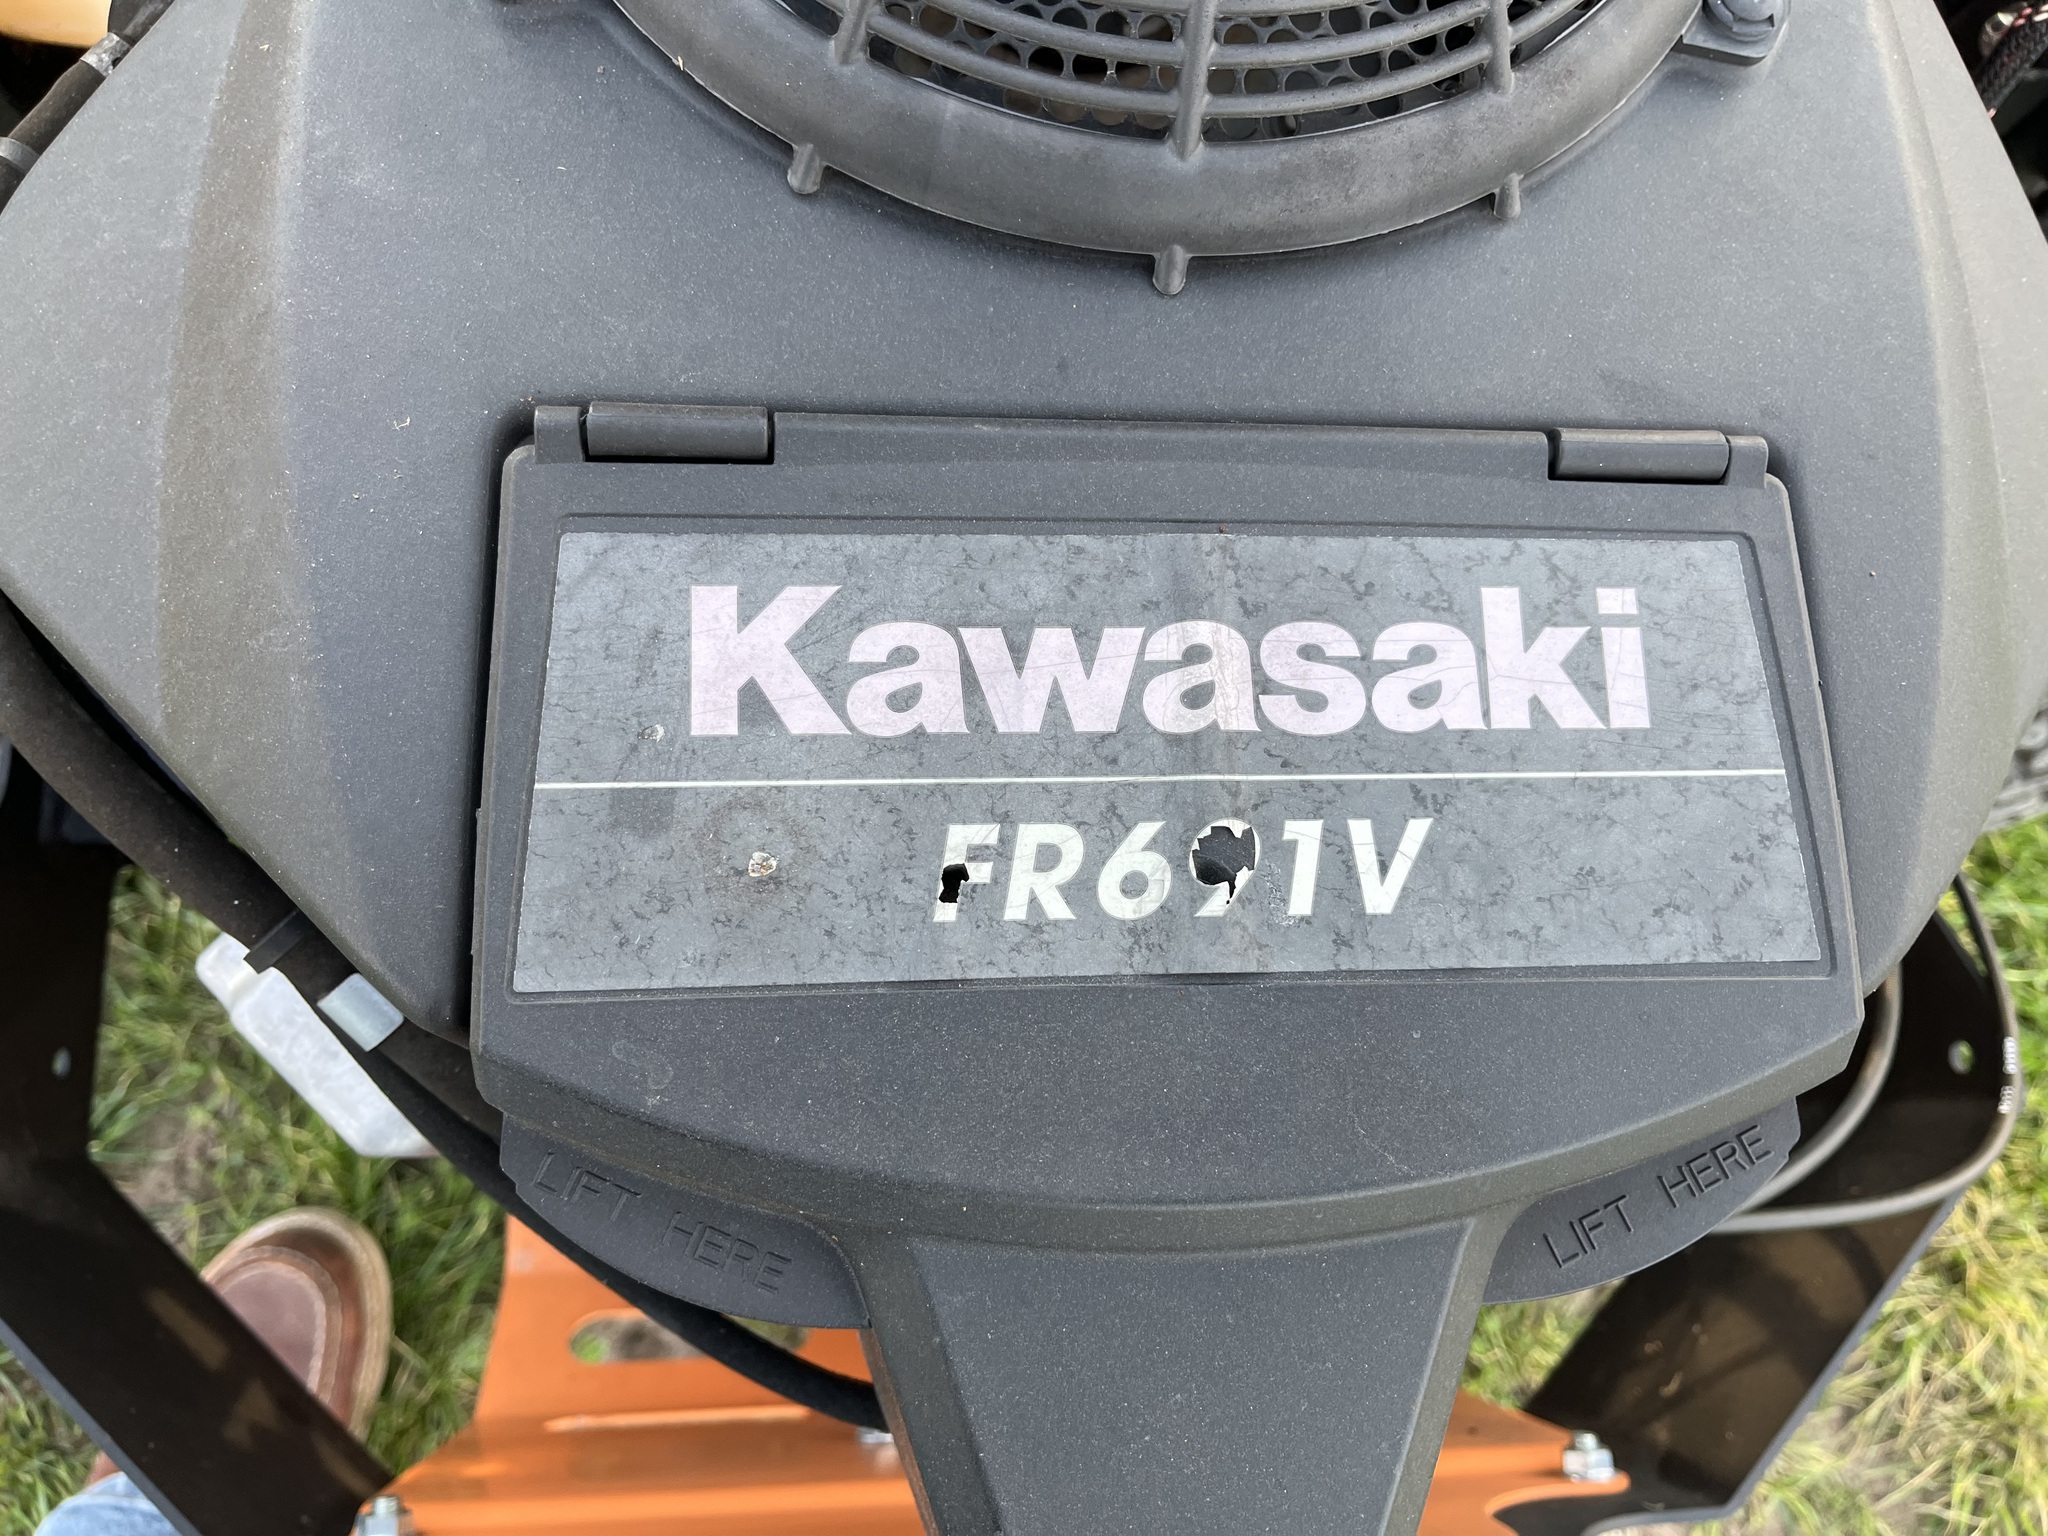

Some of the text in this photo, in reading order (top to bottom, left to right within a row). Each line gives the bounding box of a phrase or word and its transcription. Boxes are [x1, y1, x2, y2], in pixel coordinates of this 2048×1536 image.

[687, 584, 1652, 739] Kawasaki
[933, 817, 1434, 923] FR691V
[532, 1151, 793, 1296] LIFT HERE
[1541, 1124, 1775, 1268] LIFT HERE
